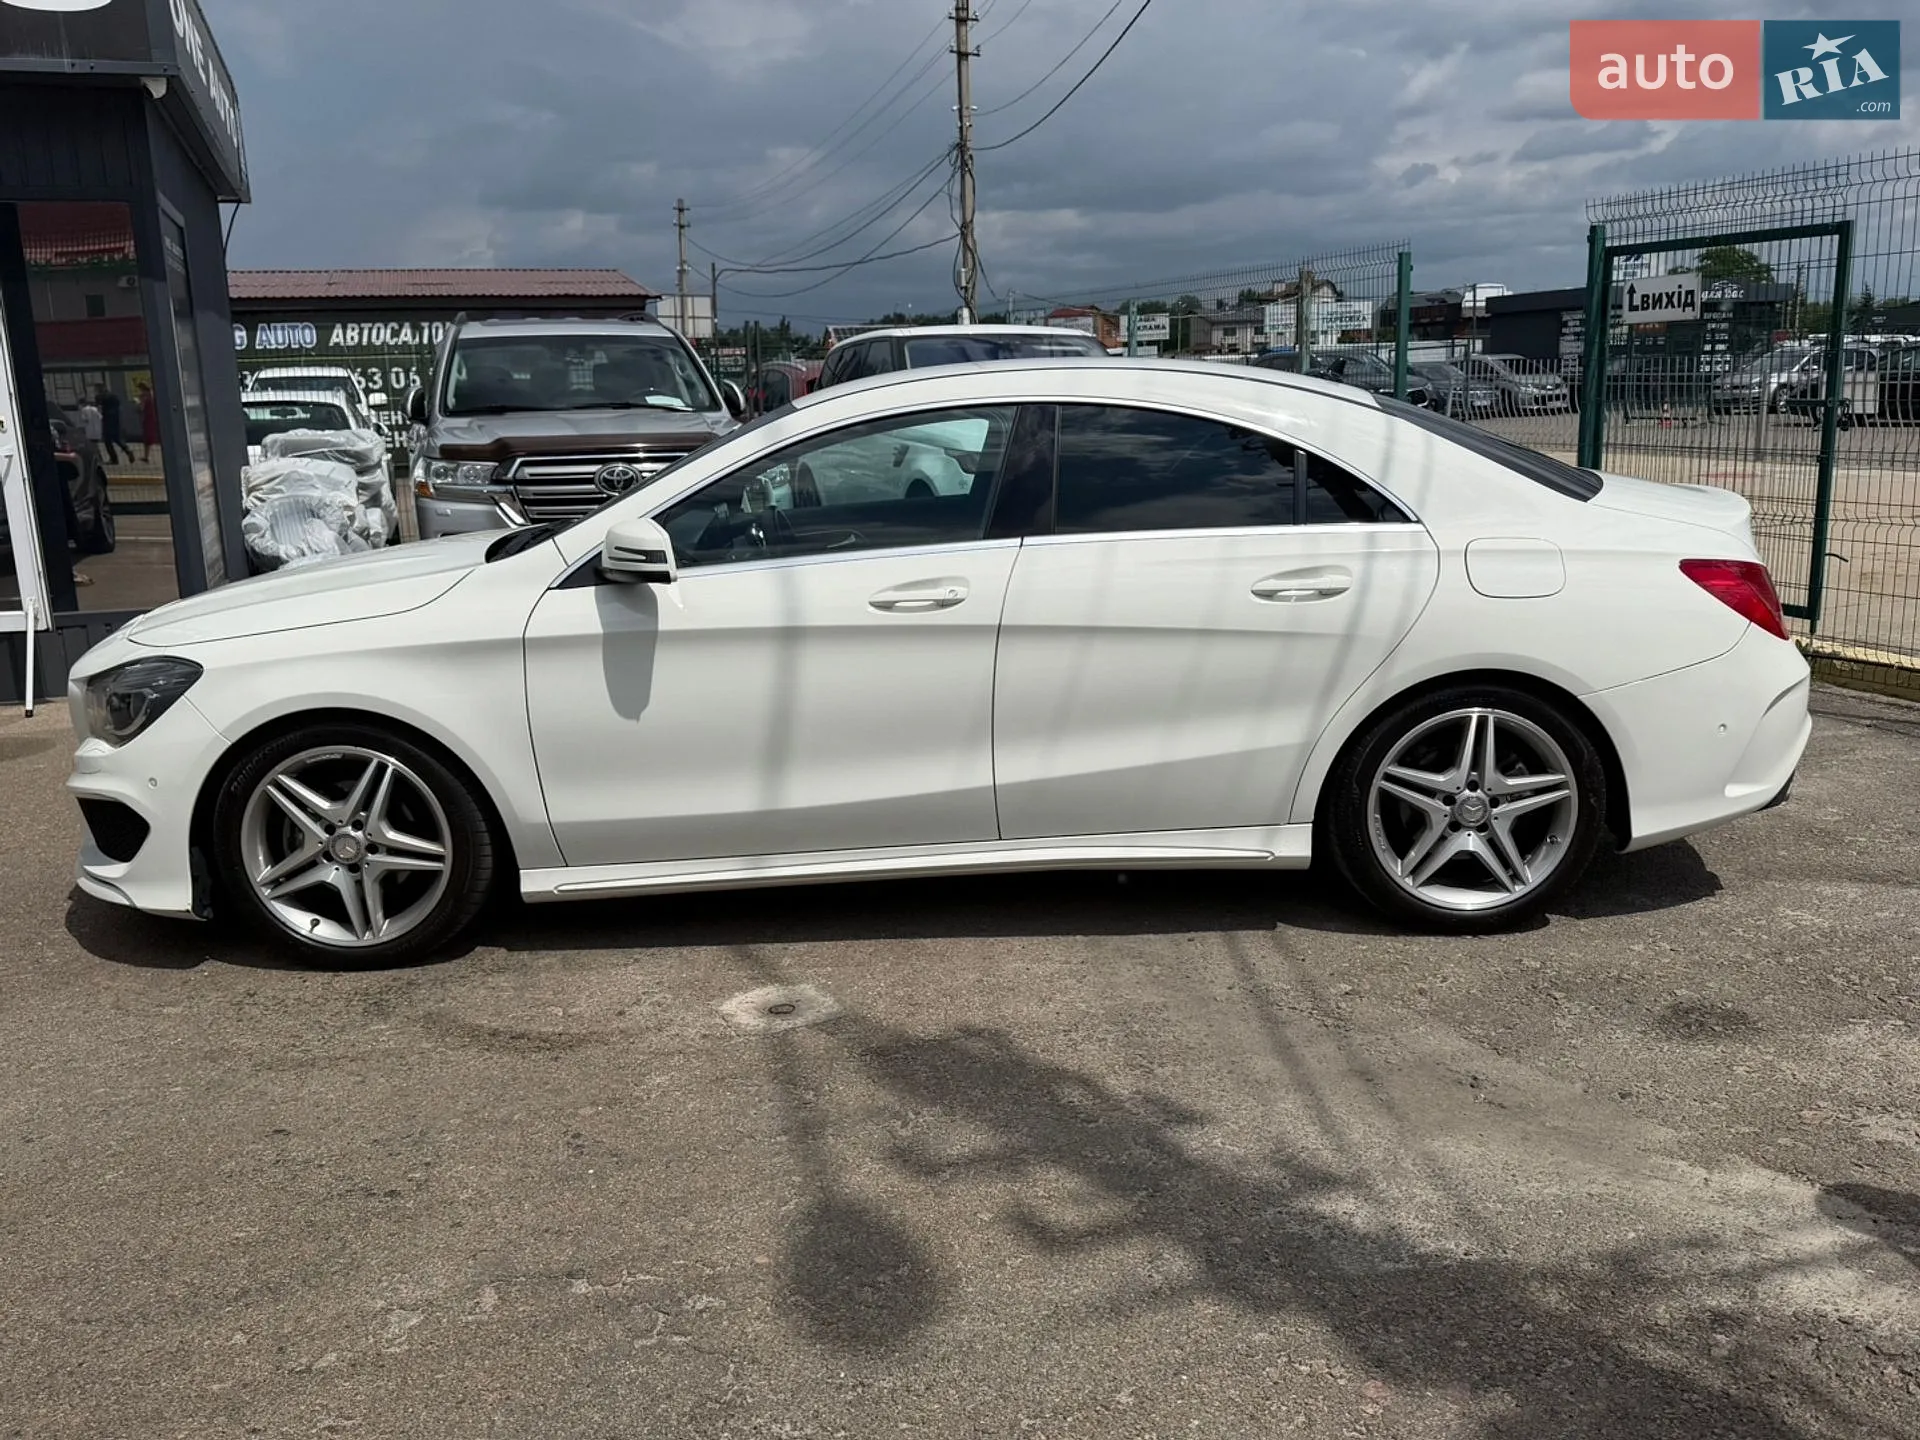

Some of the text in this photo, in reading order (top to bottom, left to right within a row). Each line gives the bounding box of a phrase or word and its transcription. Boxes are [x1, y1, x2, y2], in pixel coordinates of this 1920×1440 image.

[169, 0, 207, 87] ONE
[1640, 284, 1696, 312] вихід
[255, 322, 317, 349] AUTO
